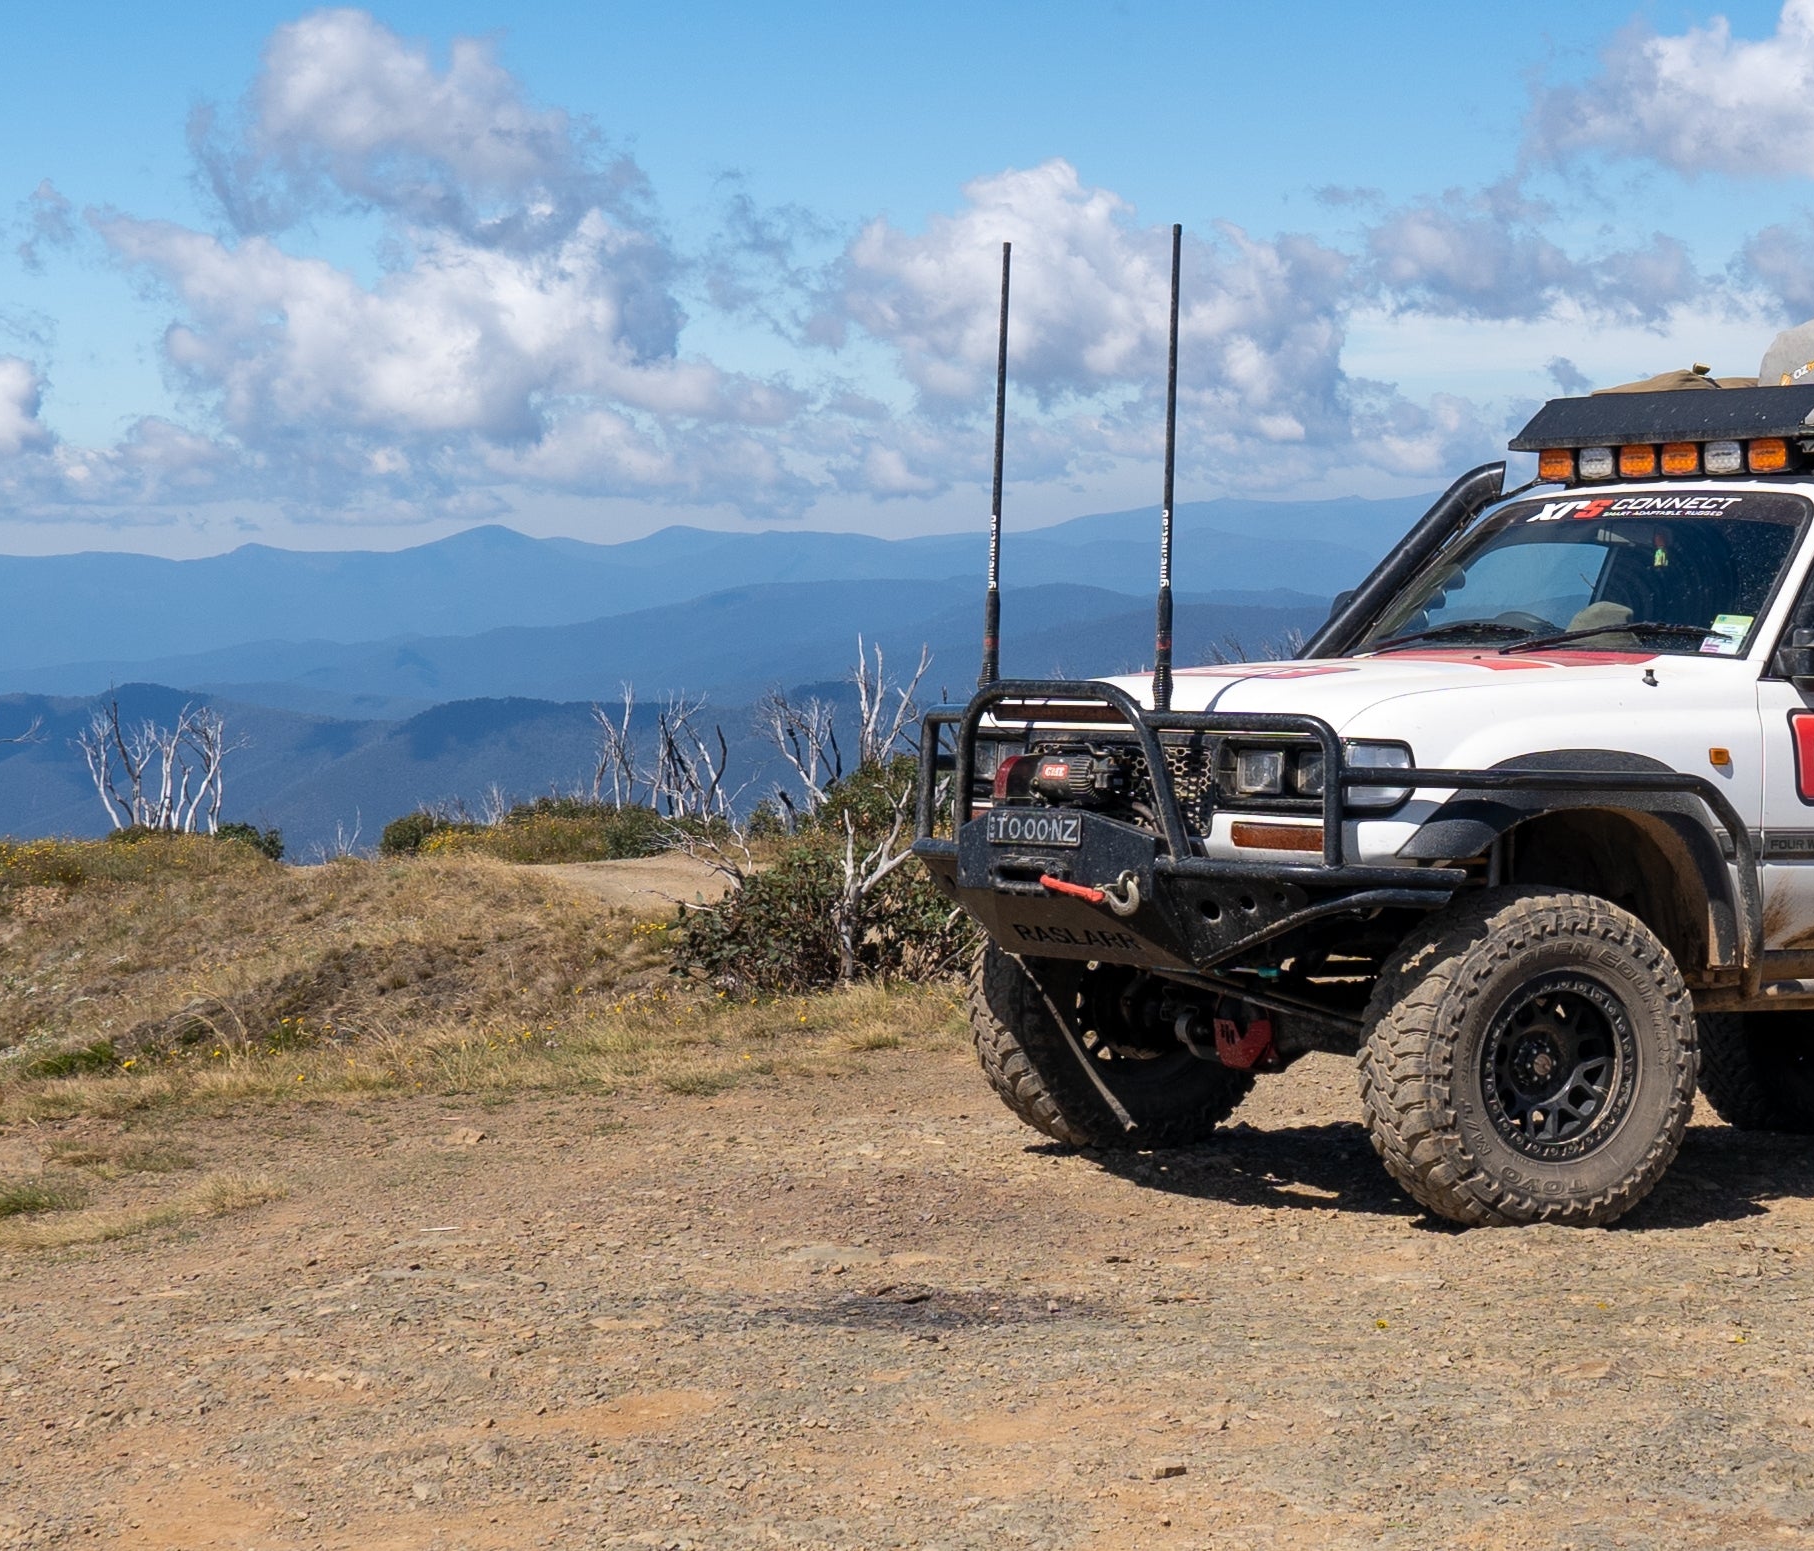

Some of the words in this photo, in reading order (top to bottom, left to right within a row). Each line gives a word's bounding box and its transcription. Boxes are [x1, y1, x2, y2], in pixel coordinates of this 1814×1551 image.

[1610, 497, 1743, 511] CONNECT
[1770, 839, 1804, 850] FOUR
[1012, 923, 1143, 951] RASLARR
